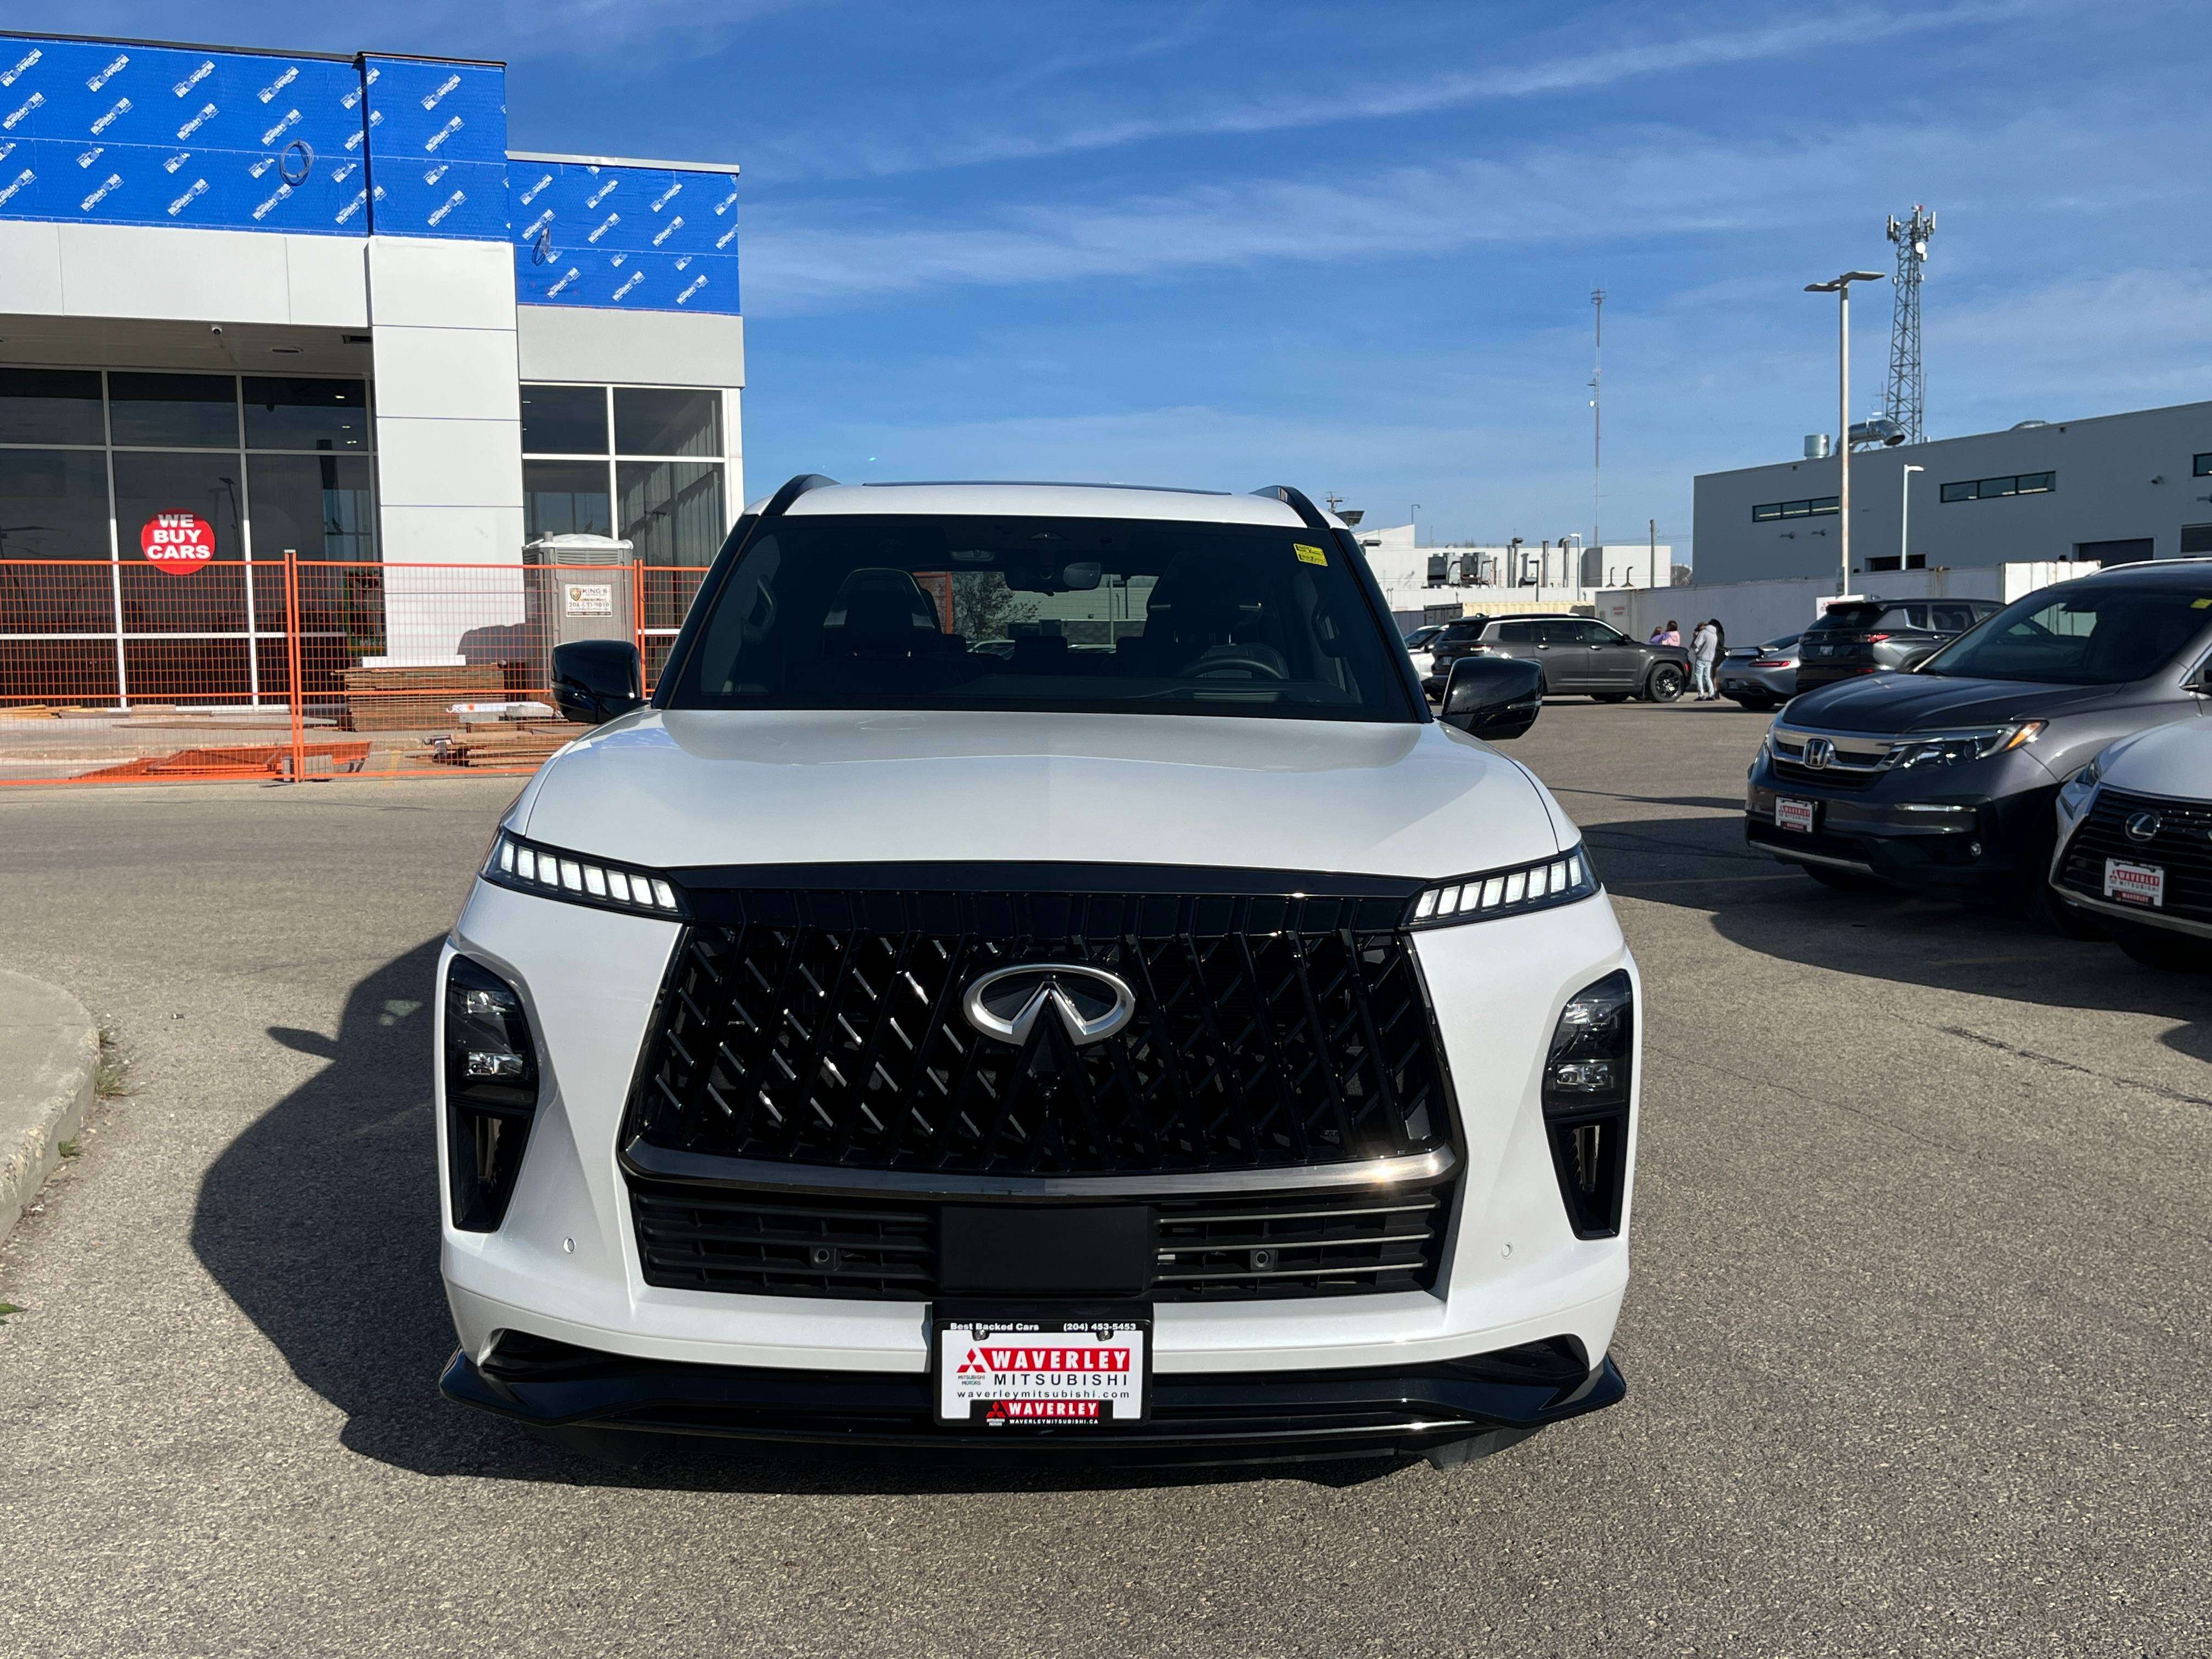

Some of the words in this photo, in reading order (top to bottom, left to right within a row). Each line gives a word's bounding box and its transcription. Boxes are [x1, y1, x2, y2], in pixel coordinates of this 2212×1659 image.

[158, 515, 194, 528] WE
[154, 529, 202, 543] BUY
[147, 545, 210, 560] CARS
[2118, 871, 2159, 886] WAVERLEY
[975, 1323, 1013, 1331] Backed
[1015, 1323, 1040, 1331] Cars
[1063, 1323, 1088, 1331] (204)
[1091, 1323, 1136, 1331] 453-5453
[991, 1351, 1127, 1369] WAVERLEY
[994, 1374, 1127, 1386] MITSUBISHI
[957, 1389, 1129, 1400] waverleymitsubishi.com
[1008, 1403, 1097, 1415] WAVERLEY
